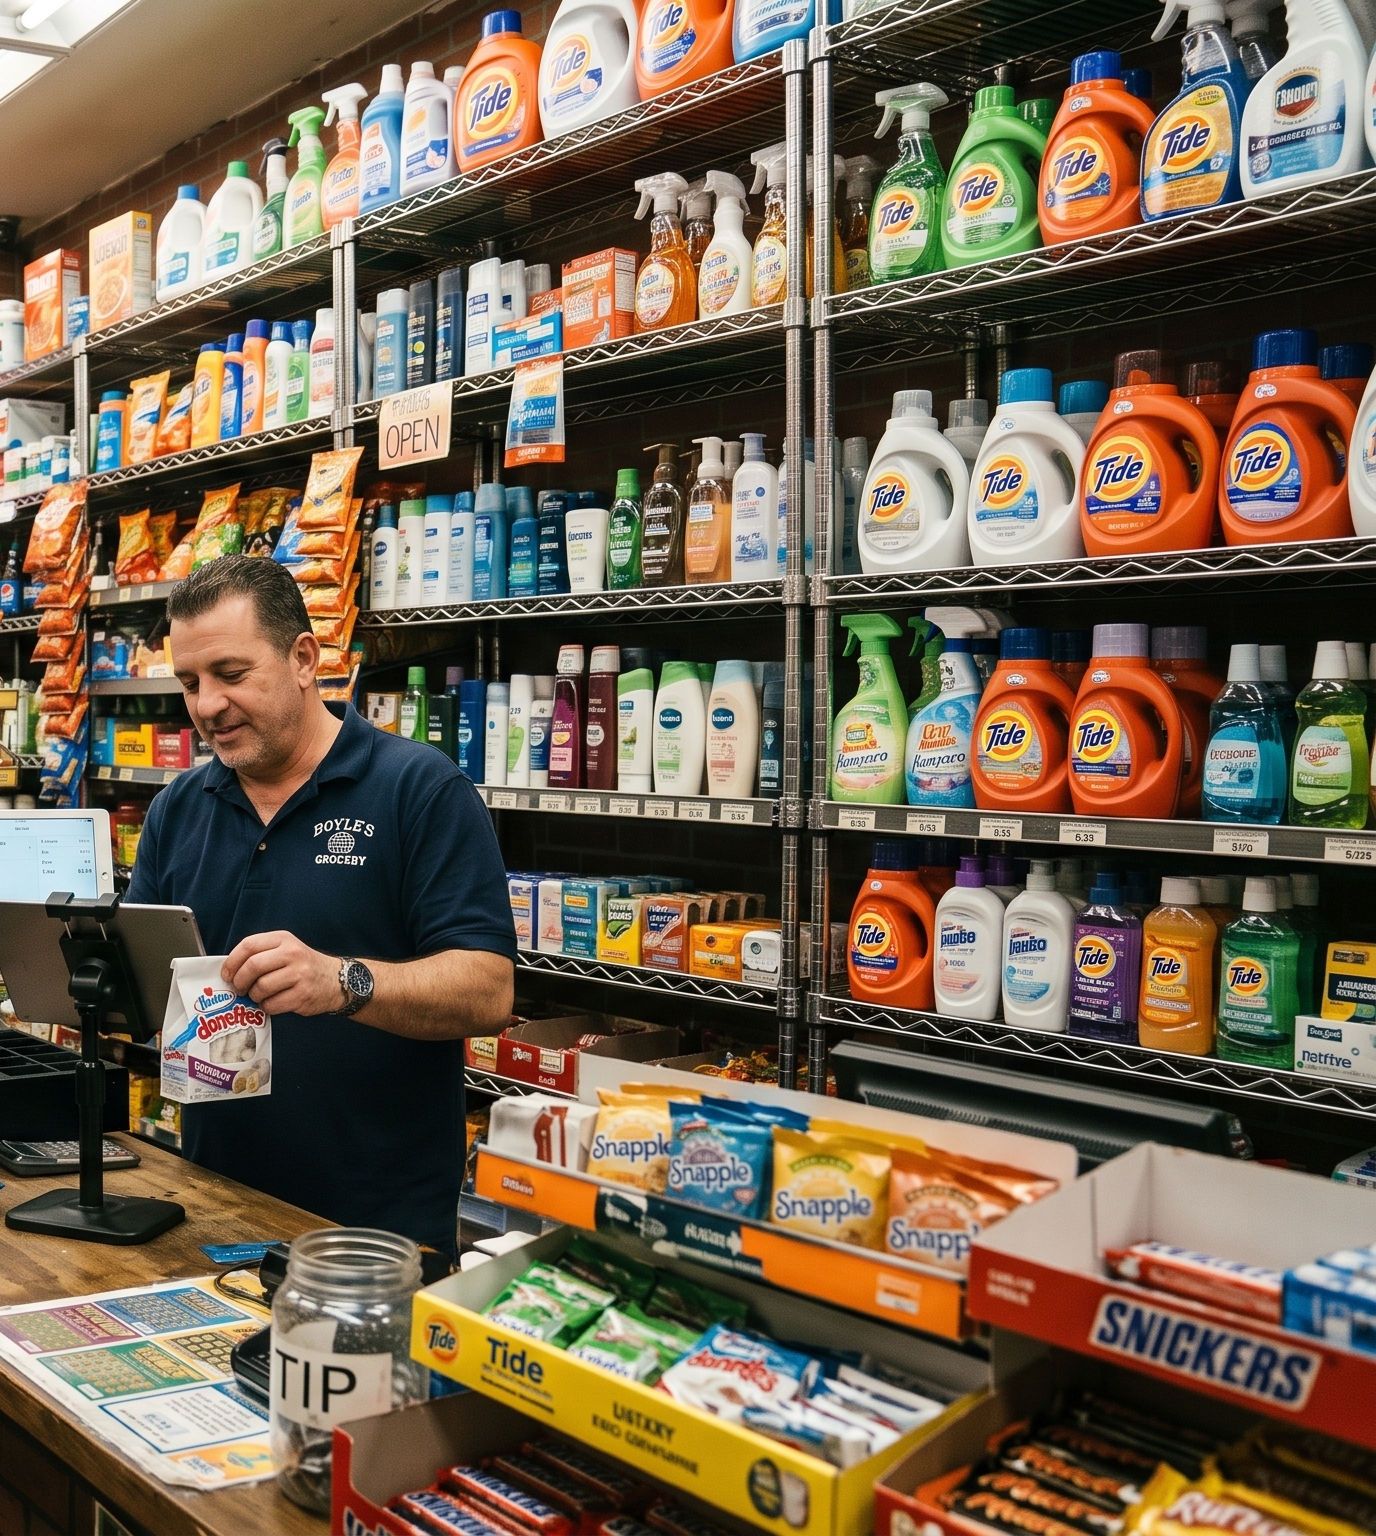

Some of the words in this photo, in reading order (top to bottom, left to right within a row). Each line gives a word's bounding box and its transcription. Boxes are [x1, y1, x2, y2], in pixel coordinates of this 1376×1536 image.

[649, 4, 684, 44] Tide
[550, 45, 586, 88] Tide
[469, 80, 512, 131] Tide
[1160, 122, 1211, 167] Tide
[1054, 149, 1097, 187] Tide
[957, 175, 998, 208] Tide
[877, 200, 914, 233] Tide
[386, 416, 441, 459] OPEN
[1094, 453, 1144, 494] Tide
[1235, 449, 1282, 484] Tide
[870, 484, 905, 515] Tide
[982, 468, 1022, 503] Tide
[986, 722, 1025, 752] Tide
[1078, 721, 1115, 752] Tide
[313, 818, 375, 838] BOYLE'S
[857, 924, 886, 947] Tide
[1078, 945, 1109, 969] Tide
[1151, 956, 1181, 977] Tide
[1230, 965, 1261, 987] Tide
[671, 1157, 749, 1190] Snapple
[775, 1187, 872, 1225] Snapple
[890, 1219, 980, 1261] Snapp
[428, 1324, 457, 1352] Tide
[1097, 1300, 1312, 1404] SNICKERS
[486, 1335, 544, 1385] Tide
[275, 1348, 358, 1414] TIP
